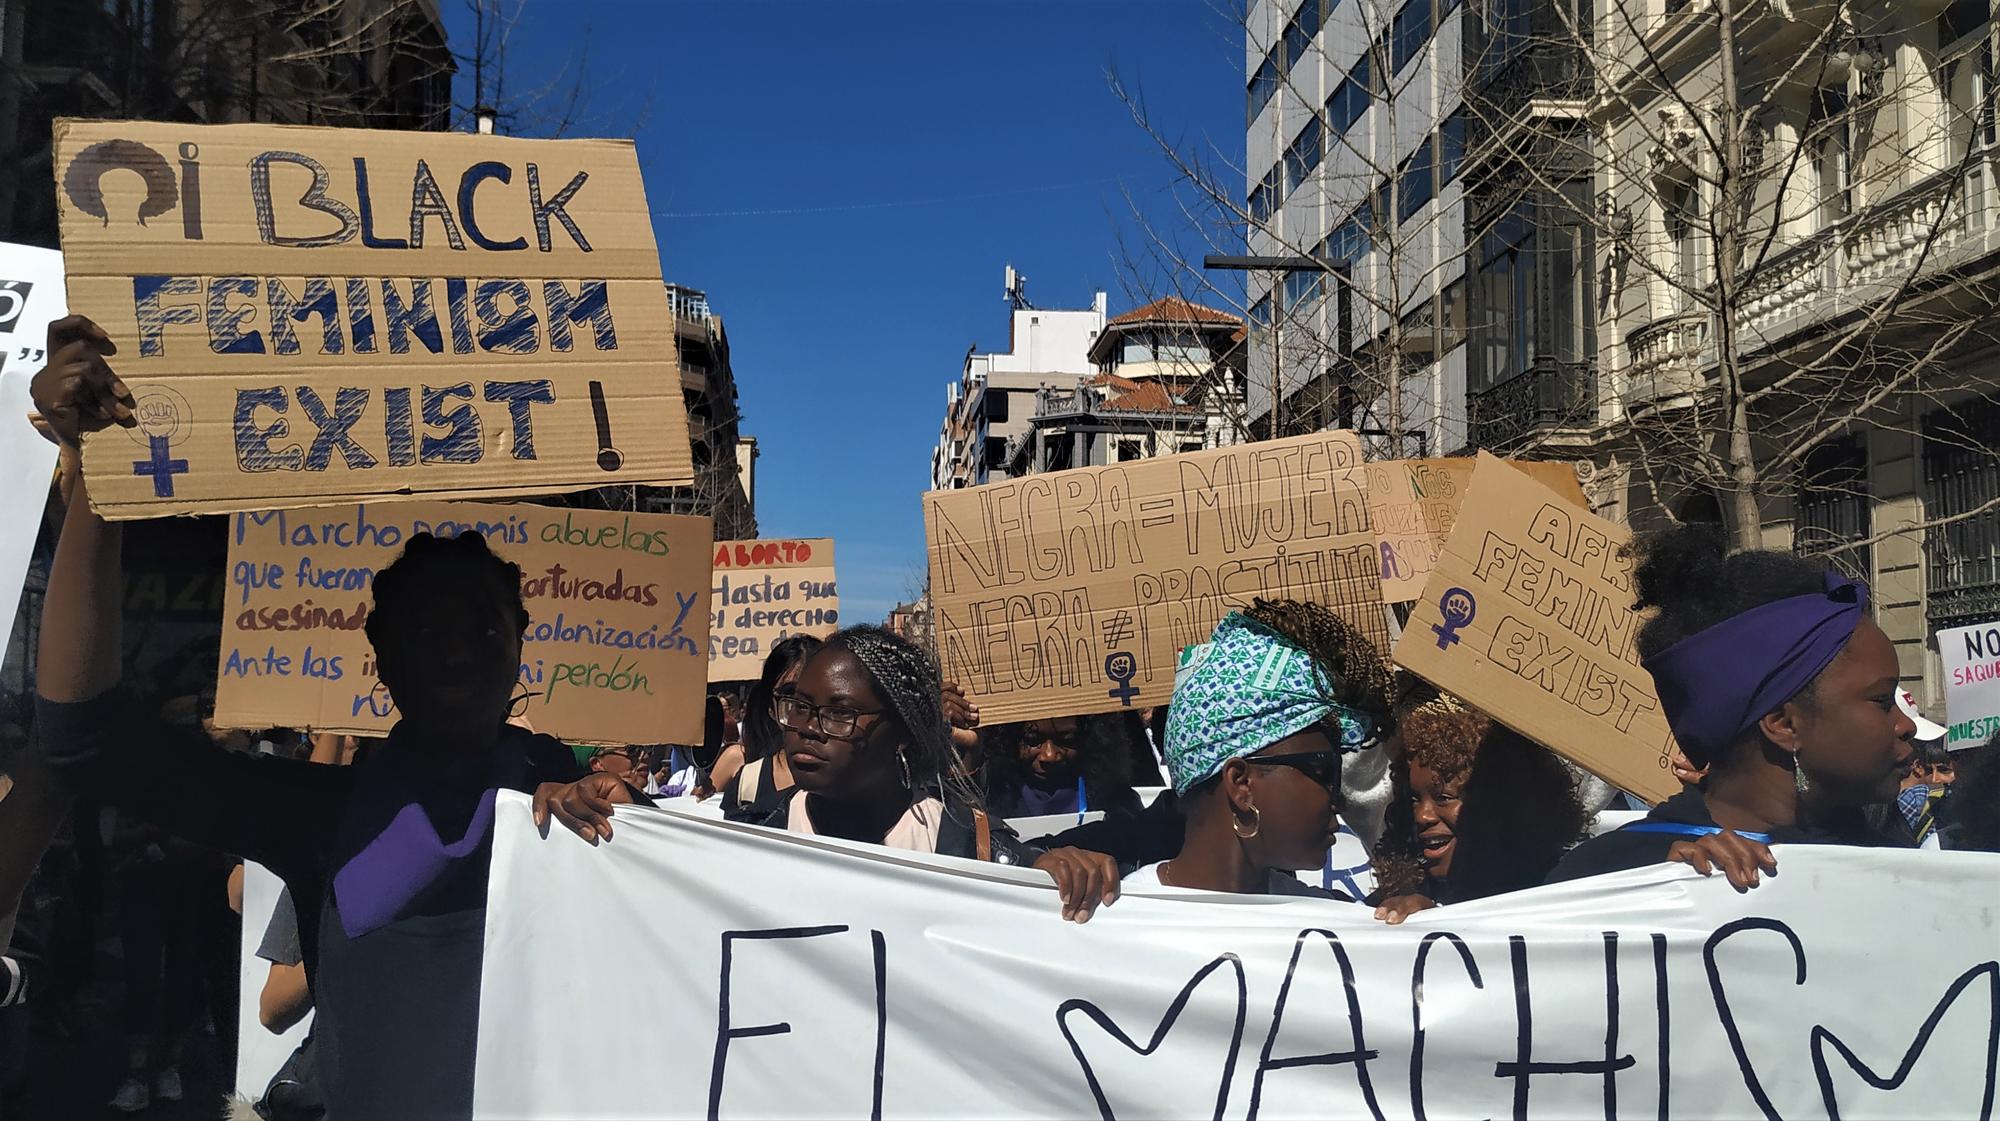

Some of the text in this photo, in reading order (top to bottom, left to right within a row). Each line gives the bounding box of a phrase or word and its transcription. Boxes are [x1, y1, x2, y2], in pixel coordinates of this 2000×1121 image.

[250, 149, 594, 253] BLACK
[133, 274, 619, 358] FEMINISM
[233, 378, 556, 473] EXIST
[236, 503, 401, 547] Marcho
[540, 511, 670, 556] abuelas
[713, 541, 812, 568] ABORTO
[933, 467, 1145, 594] NEGRA
[1179, 440, 1371, 556] MUJER
[1527, 503, 1635, 593] AFR
[233, 560, 285, 606] que
[296, 556, 375, 591] fueron
[518, 562, 658, 607] orturadas
[235, 599, 368, 632] asesinad
[711, 574, 791, 607] Hasta
[1472, 530, 1643, 667] FEMINI
[223, 646, 292, 679] Ante
[301, 645, 344, 681] las
[544, 653, 655, 706] perdón
[940, 586, 1102, 696] NEGRA
[1487, 615, 1658, 735] EXIST
[1963, 628, 2000, 661] NO
